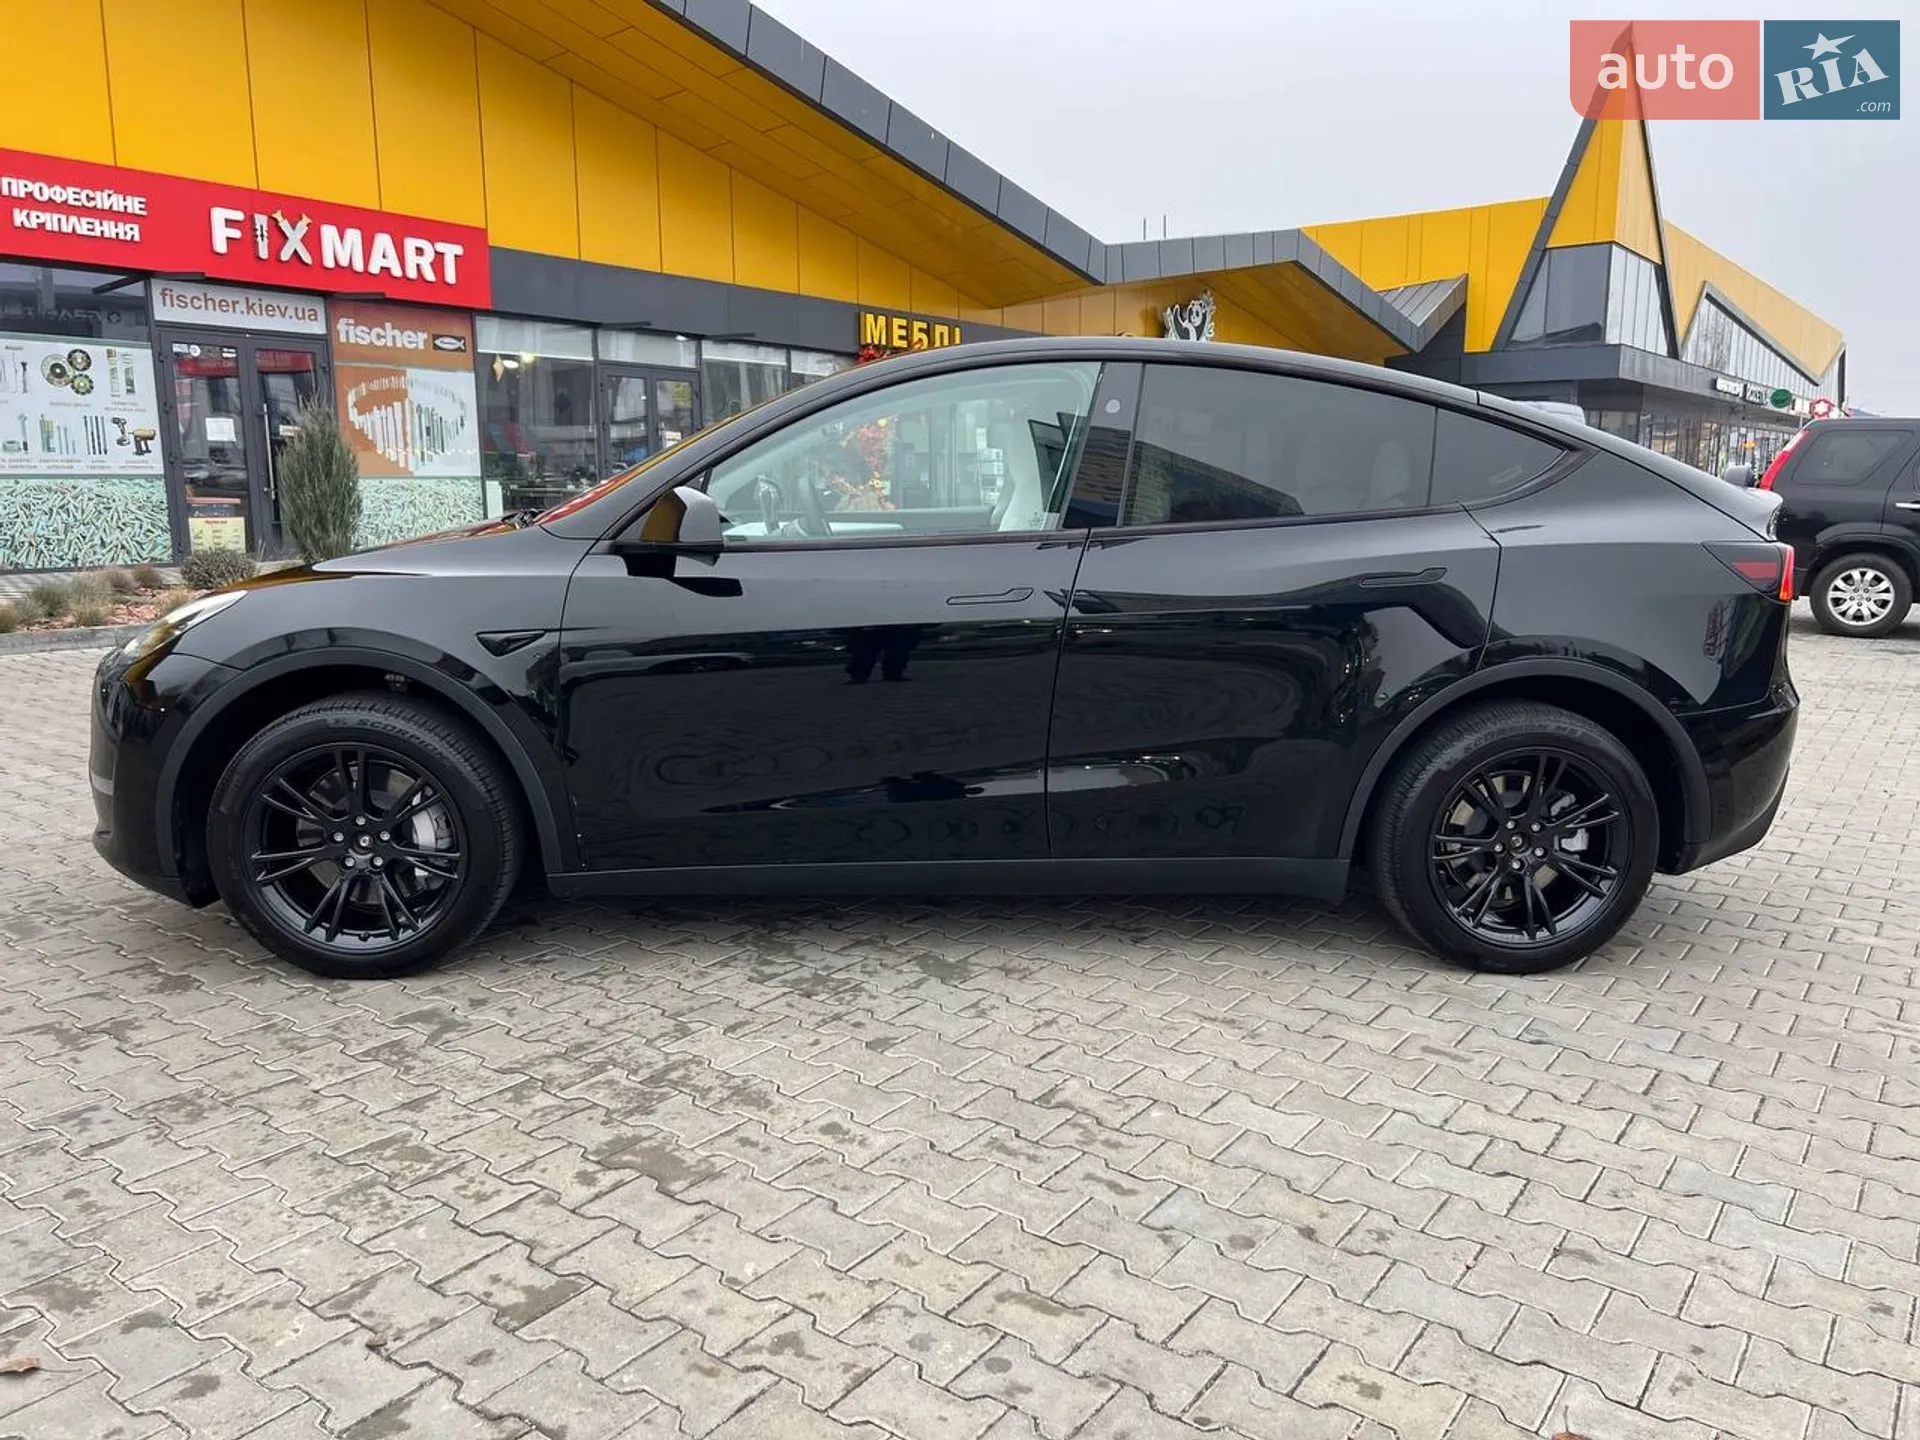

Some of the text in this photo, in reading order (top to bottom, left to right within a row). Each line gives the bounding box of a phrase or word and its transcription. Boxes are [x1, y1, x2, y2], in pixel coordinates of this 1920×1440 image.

[1, 176, 148, 216] ПРОФЕСІЙНЕ
[12, 207, 141, 242] КРІПЛЕННЯ
[159, 287, 319, 323] fischer.kiev.ua
[336, 317, 428, 350] fischer
[864, 313, 961, 350] МЕБЛІ
